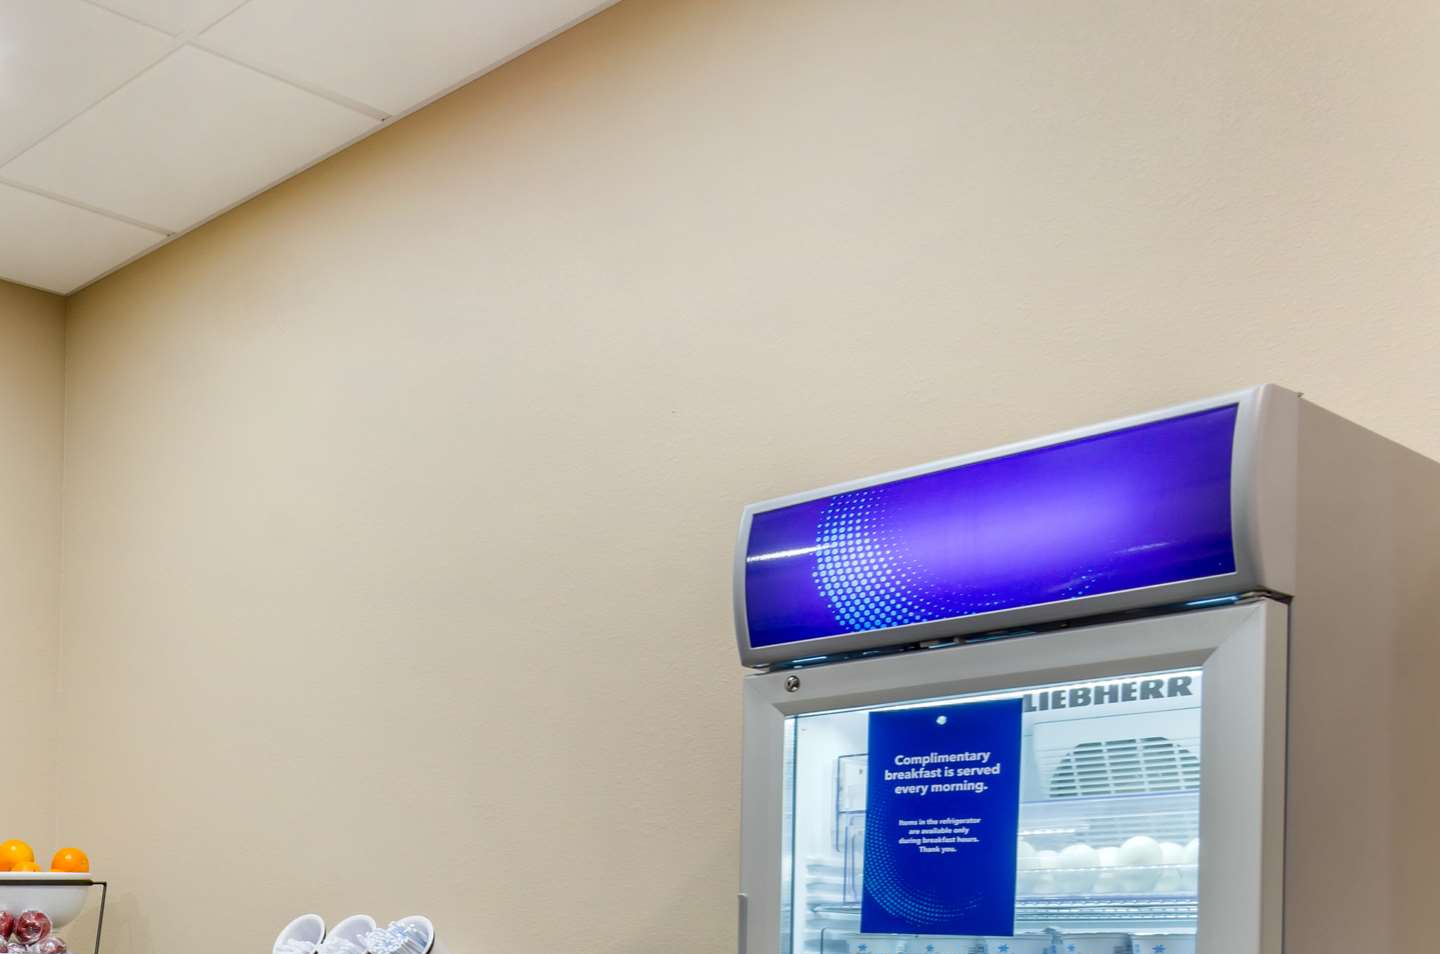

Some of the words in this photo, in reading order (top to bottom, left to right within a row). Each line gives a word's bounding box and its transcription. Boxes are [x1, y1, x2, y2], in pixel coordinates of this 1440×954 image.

[1023, 676, 1193, 713] LIEBHERR
[894, 751, 991, 767] Complimentary
[884, 767, 942, 781] breakfast
[944, 766, 955, 777] is
[956, 762, 1001, 776] served
[894, 784, 929, 796] every
[931, 780, 989, 793] morning.
[953, 826, 970, 835] only
[922, 836, 956, 844] breakfast
[919, 845, 940, 853] Thank
